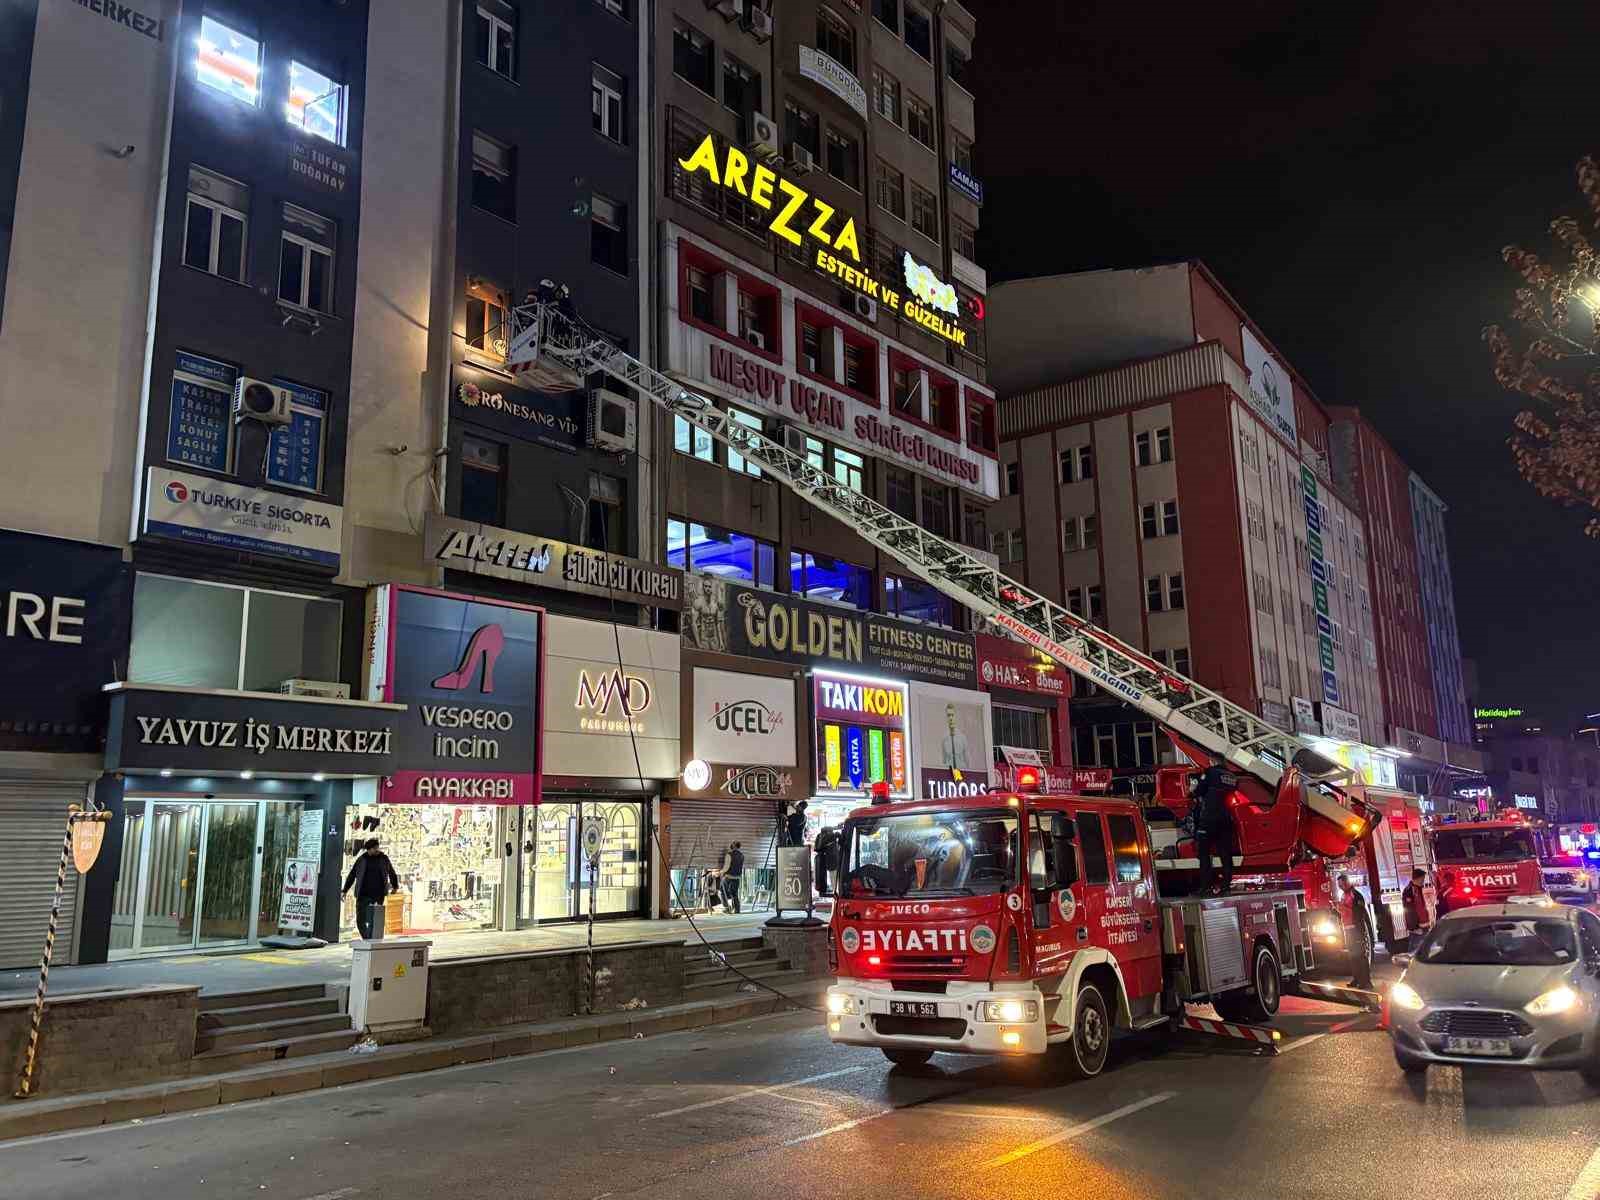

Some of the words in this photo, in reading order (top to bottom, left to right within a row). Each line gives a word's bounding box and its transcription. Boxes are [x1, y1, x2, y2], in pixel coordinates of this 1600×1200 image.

[678, 133, 860, 262] AREZZA
[816, 249, 879, 298] ESTETİK
[881, 286, 899, 309] VE
[904, 298, 967, 346] GÜZELLİK
[710, 344, 786, 404] MESUT
[790, 380, 845, 430] UÇAN
[855, 414, 927, 461] SÜRÜCÜ
[926, 444, 981, 484] KURSU
[266, 504, 332, 529] SİGORTA
[565, 551, 628, 588] SÜRÜCÜ
[630, 567, 678, 600] KURSU
[6, 591, 87, 645] RE
[745, 602, 862, 664] GOLDEN
[869, 623, 923, 650] FITNESS
[926, 635, 974, 660] CENTER
[577, 669, 651, 717] MAD
[1036, 672, 1063, 690] döner
[1089, 665, 1144, 701] MAGIRUS
[821, 681, 903, 716] TAKIKOM
[423, 704, 513, 731] VESPERO
[1478, 708, 1508, 719] Holiday
[137, 716, 237, 747] YAVUZ
[245, 717, 270, 755] İŞ
[277, 725, 393, 755] MERKEZİ
[436, 732, 499, 759] incim
[852, 738, 861, 775] ÇANTA
[417, 777, 514, 798] AYAKKABI
[928, 780, 988, 799] TUDORS
[1075, 772, 1096, 782] HAT
[784, 878, 801, 896] 50
[891, 904, 930, 915] IVECO
[1011, 898, 1018, 909] 3
[895, 1004, 904, 1014] 38
[920, 1005, 935, 1015] 562
